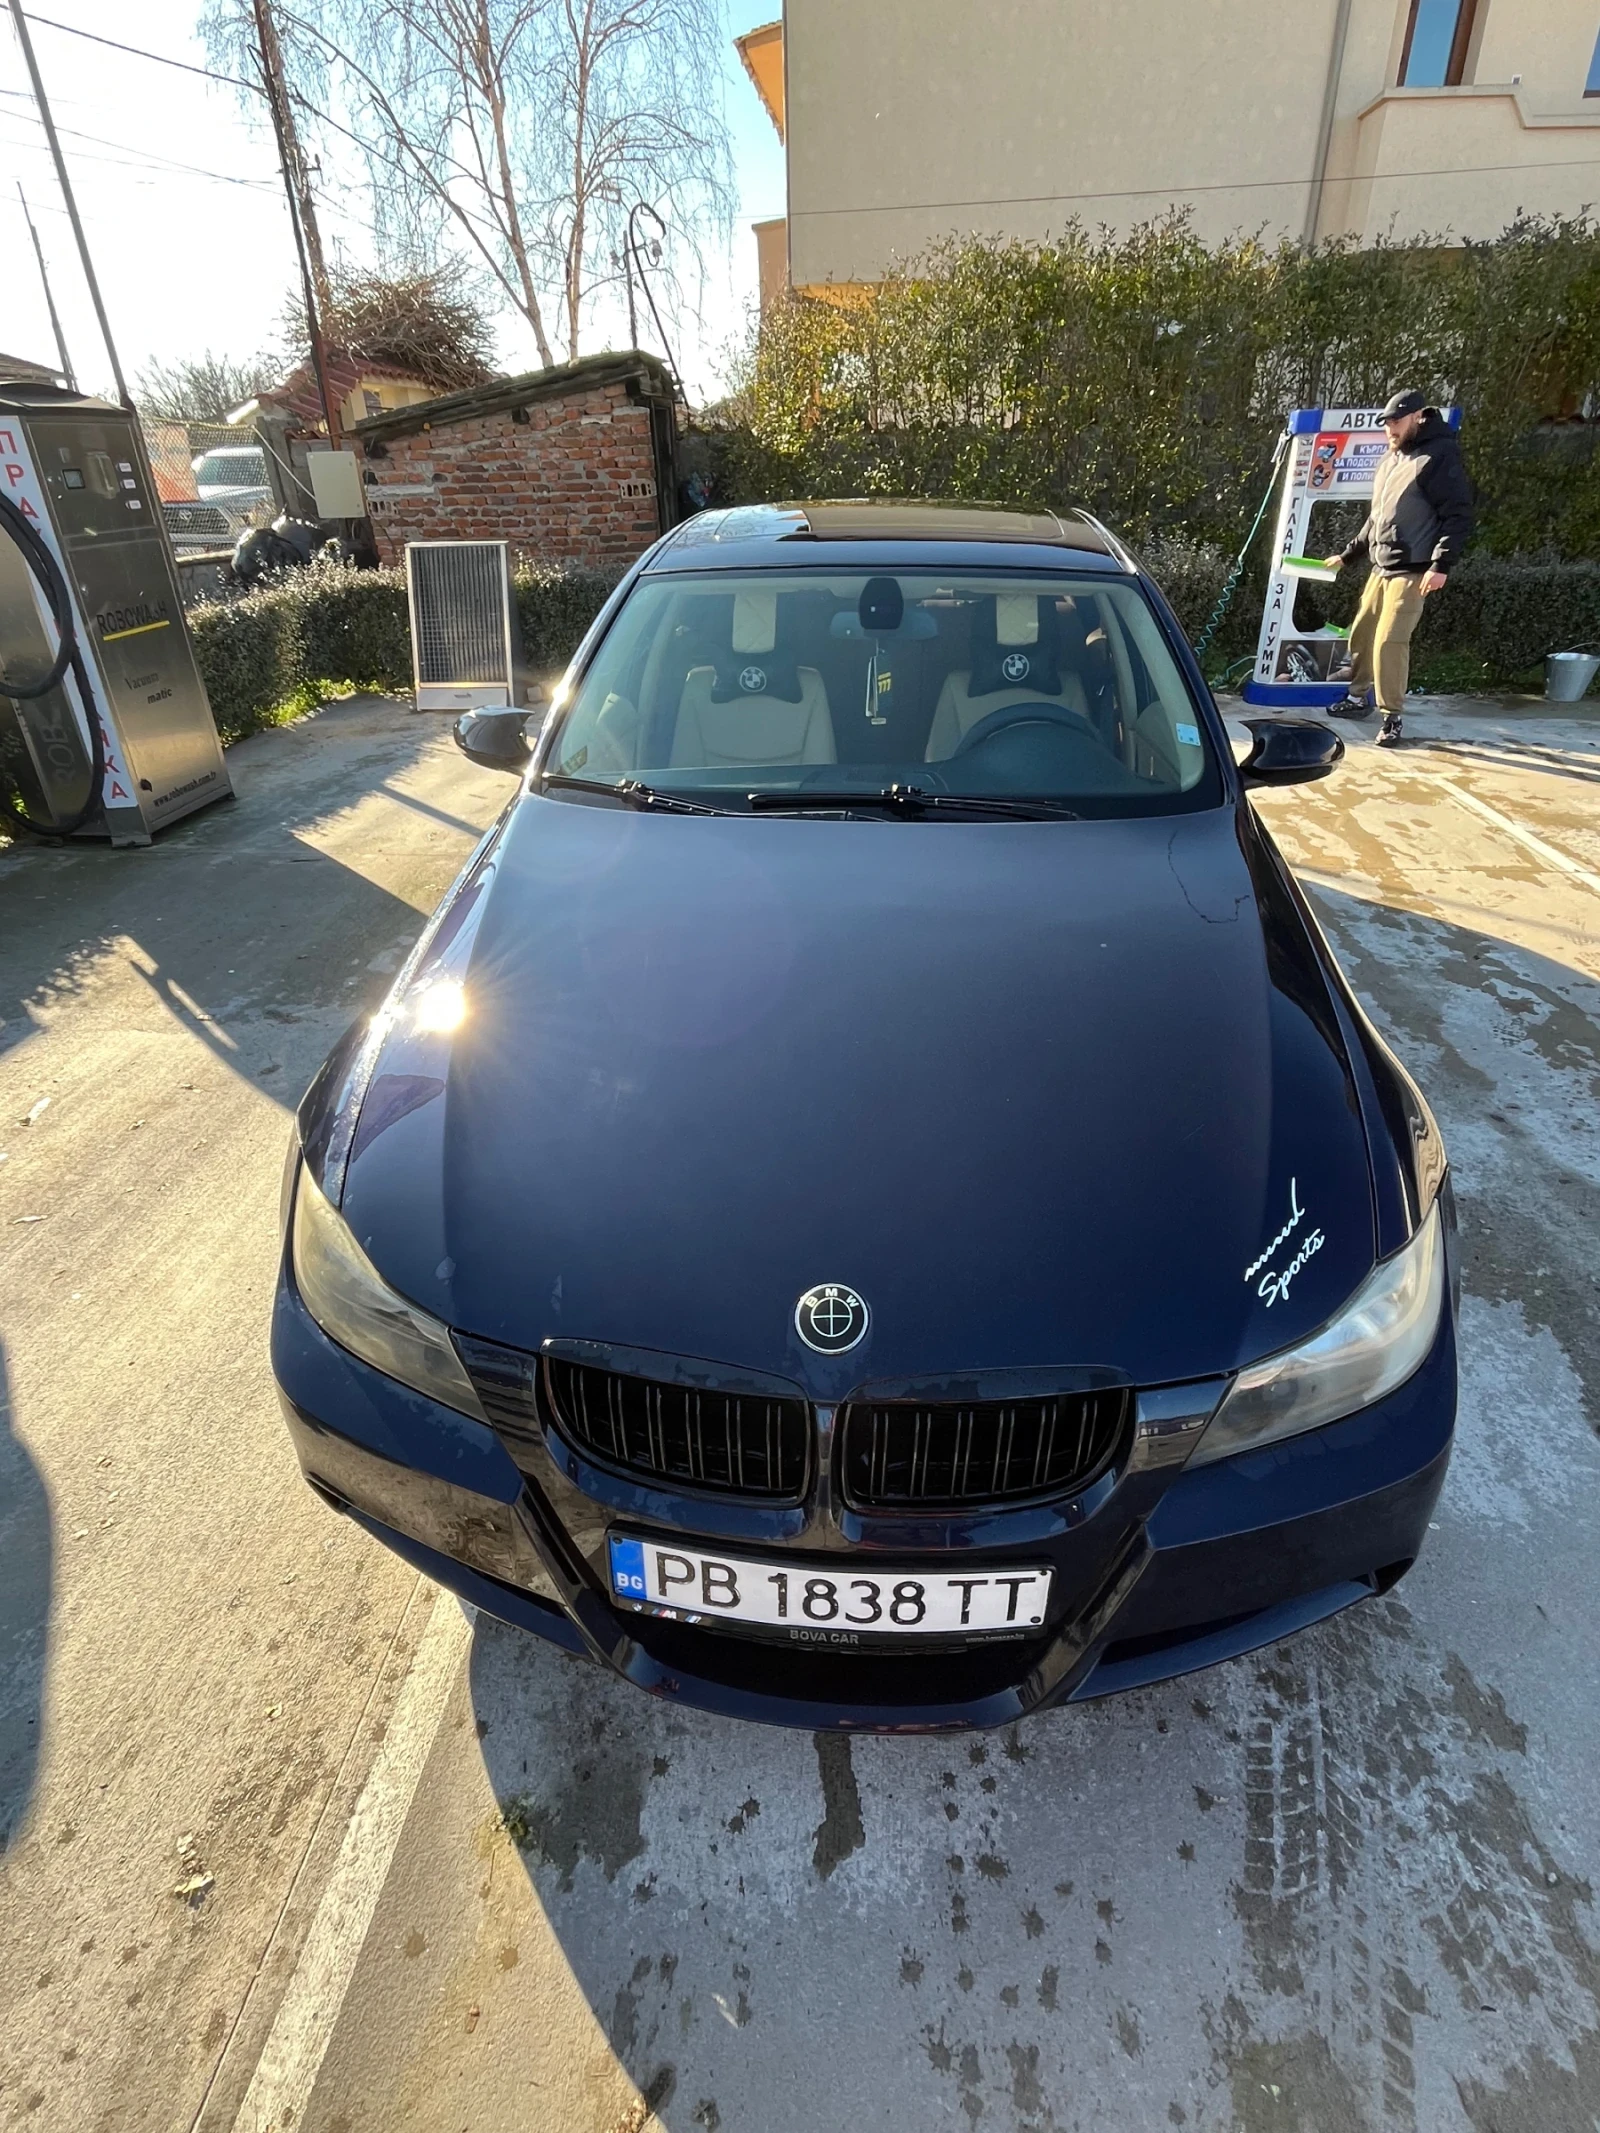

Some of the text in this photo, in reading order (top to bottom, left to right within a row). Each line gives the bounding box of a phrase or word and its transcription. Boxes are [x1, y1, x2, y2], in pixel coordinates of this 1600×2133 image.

[1334, 458, 1345, 467] ЗА
[1280, 497, 1300, 569] ГЛАН
[1261, 622, 1278, 675] ГУМИ
[1258, 1228, 1326, 1308] Sports
[804, 1287, 860, 1308] BMW
[617, 1572, 643, 1589] BG
[655, 1551, 1037, 1625] PB 1838 TT
[790, 1629, 859, 1644] BOVA CAR
